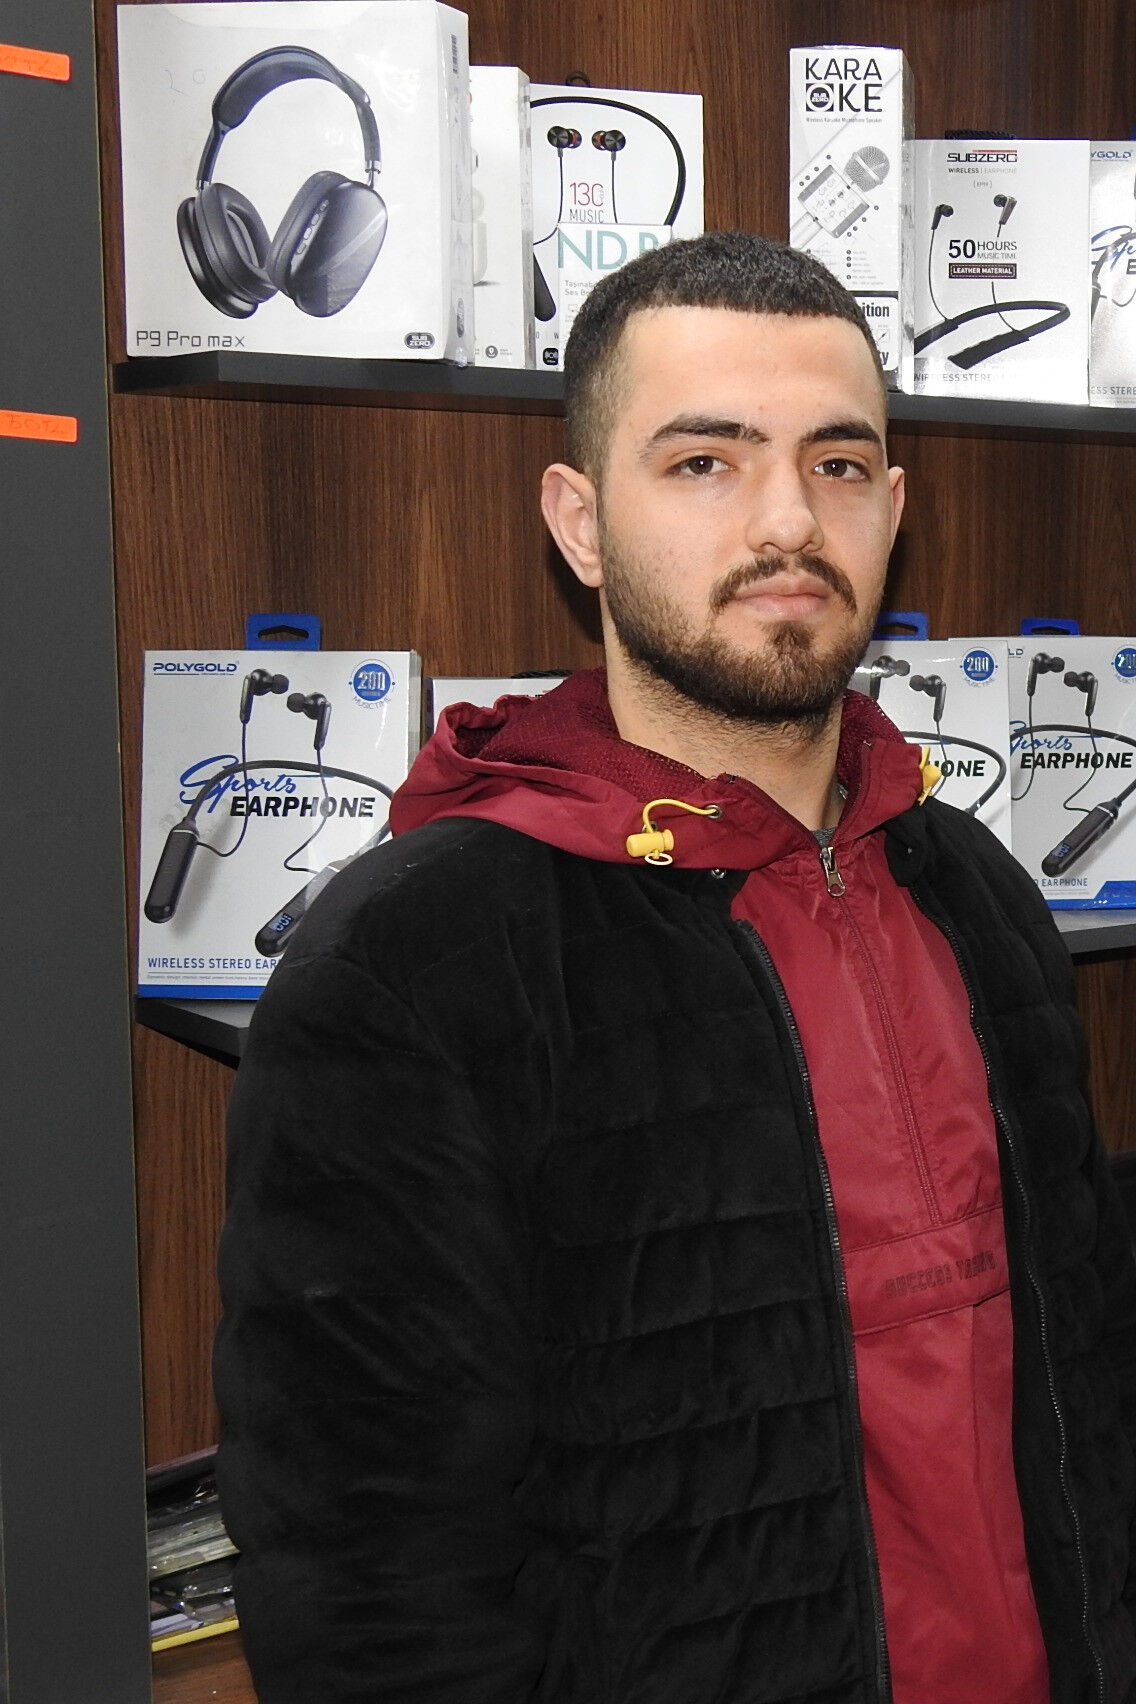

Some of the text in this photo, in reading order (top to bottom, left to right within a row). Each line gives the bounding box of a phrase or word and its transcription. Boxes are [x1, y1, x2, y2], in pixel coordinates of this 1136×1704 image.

[806, 58, 882, 80] KARA
[947, 153, 1017, 162] SUBZERO
[1090, 151, 1132, 159] YGOLD
[949, 239, 1017, 259] 50 HOURS
[861, 303, 889, 317] ition
[137, 331, 245, 347] P9 Pro max
[153, 662, 237, 672] POLYGOLD
[1020, 752, 1133, 770] EARPHONE
[180, 755, 300, 813] Sports
[230, 796, 376, 818] EARPHONE
[1042, 878, 1088, 887] EARPHONE
[148, 957, 205, 969] WIRELESS
[209, 958, 251, 969] STEREO
